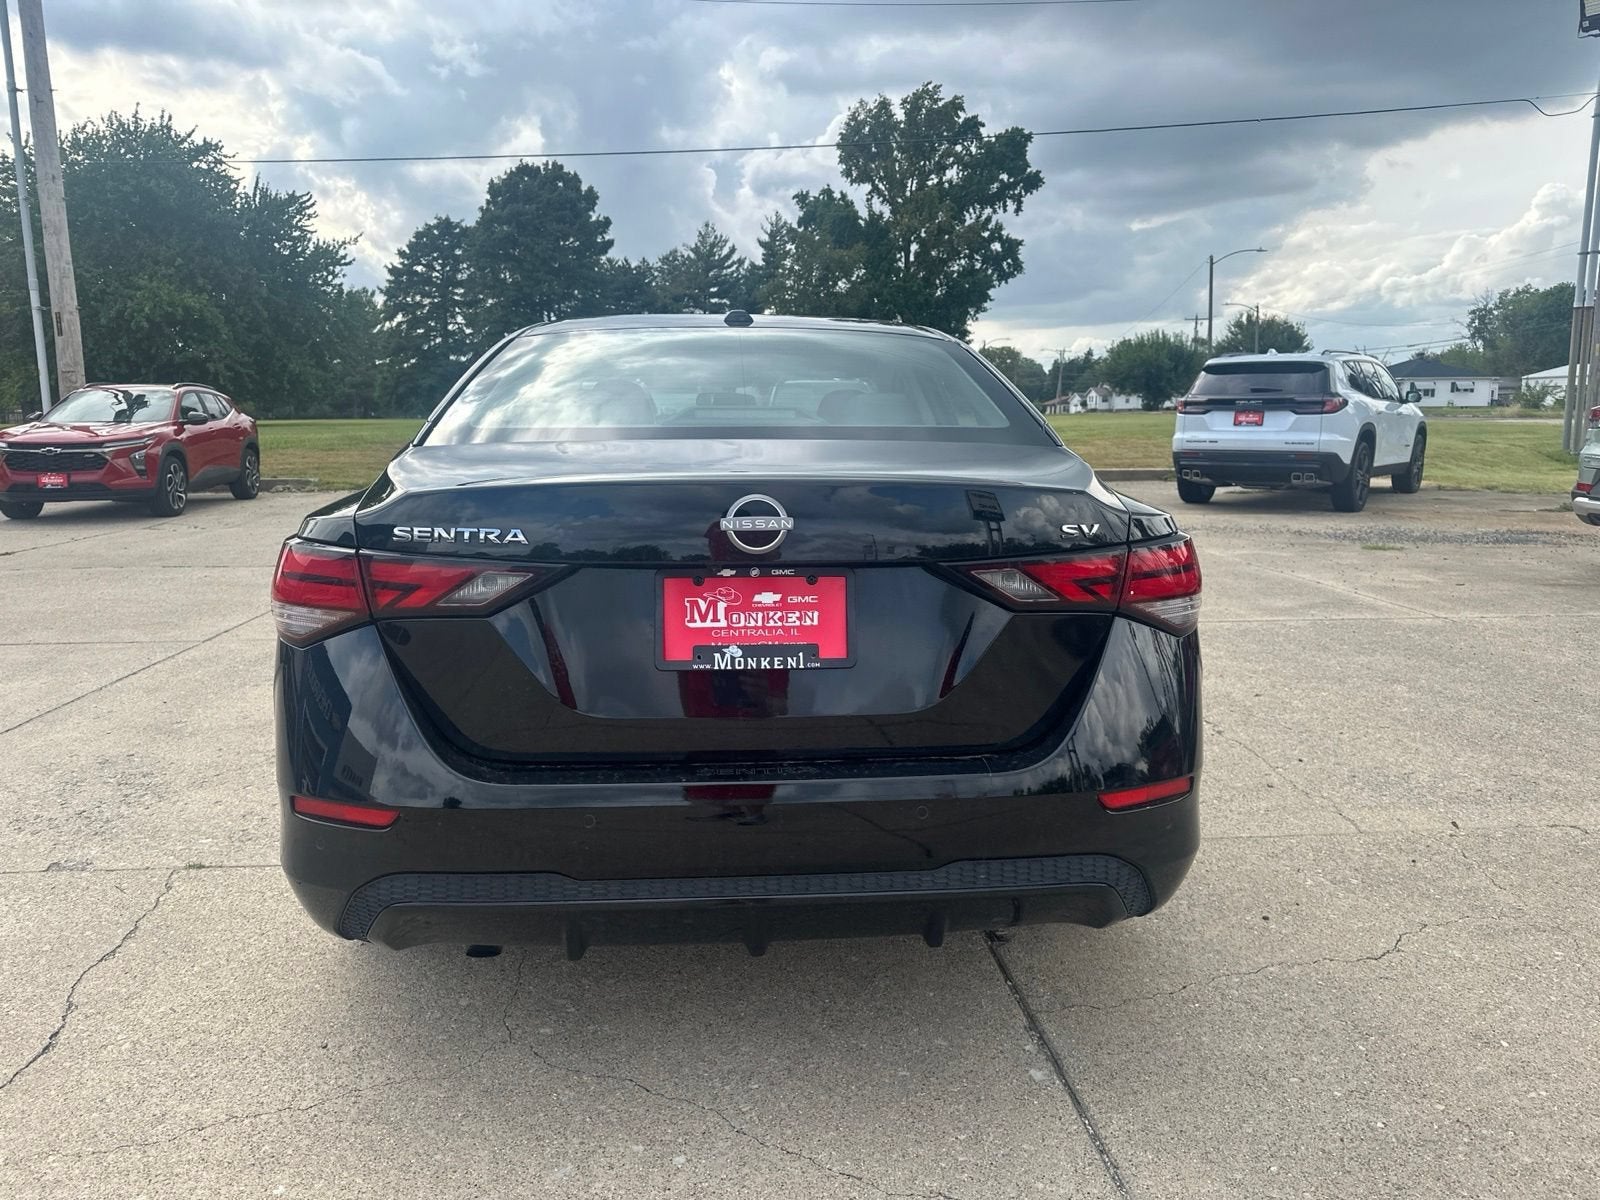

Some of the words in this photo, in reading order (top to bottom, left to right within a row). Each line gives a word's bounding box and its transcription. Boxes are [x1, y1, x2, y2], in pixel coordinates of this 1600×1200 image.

[722, 519, 793, 529] NISSAN
[392, 526, 529, 545] SENTRA
[1061, 523, 1100, 538] SV
[787, 595, 819, 603] GMC
[711, 629, 788, 637] CENTRALIA,
[790, 628, 801, 636] IL
